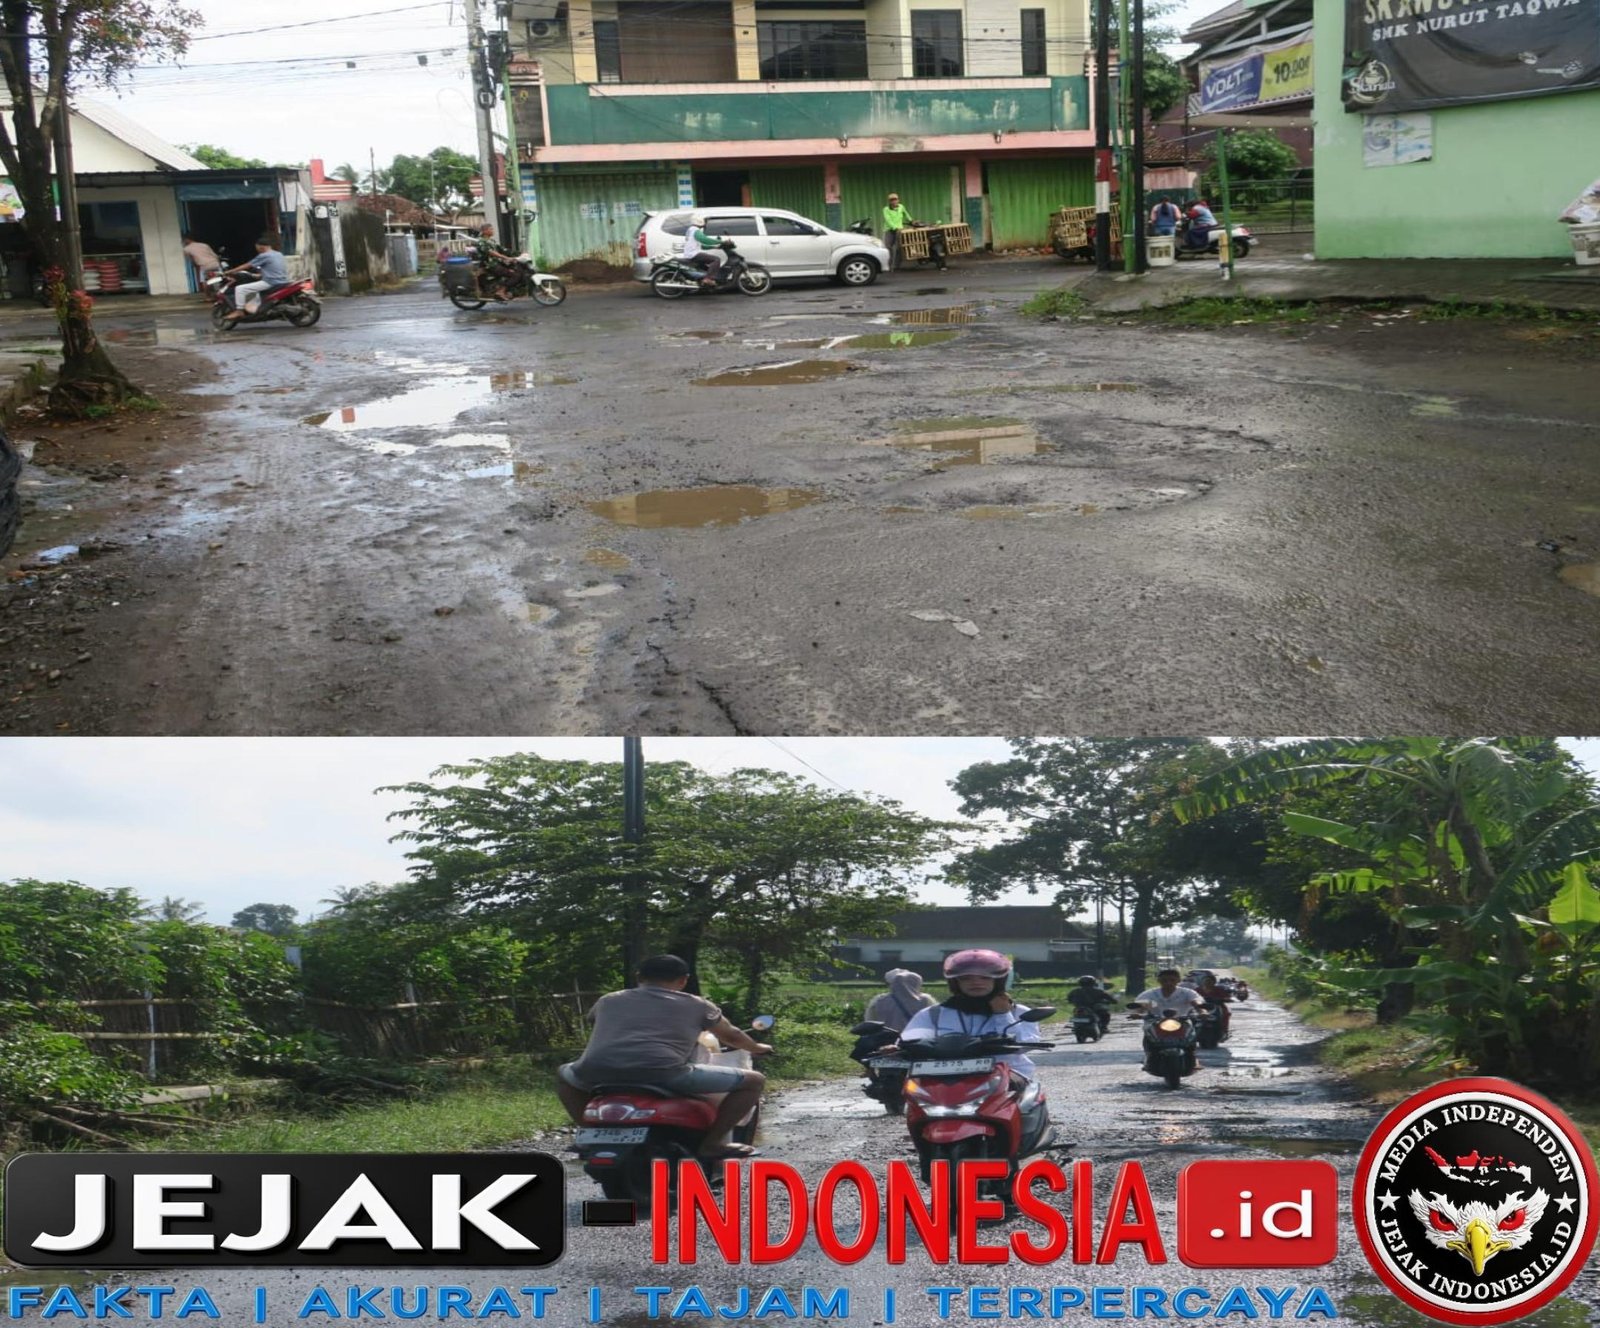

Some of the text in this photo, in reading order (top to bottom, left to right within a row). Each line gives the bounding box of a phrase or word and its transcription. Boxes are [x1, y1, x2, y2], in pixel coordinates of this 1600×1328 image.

[1372, 24, 1409, 41] SMK
[1417, 9, 1489, 34] NURUT
[1206, 68, 1244, 98] VOLT
